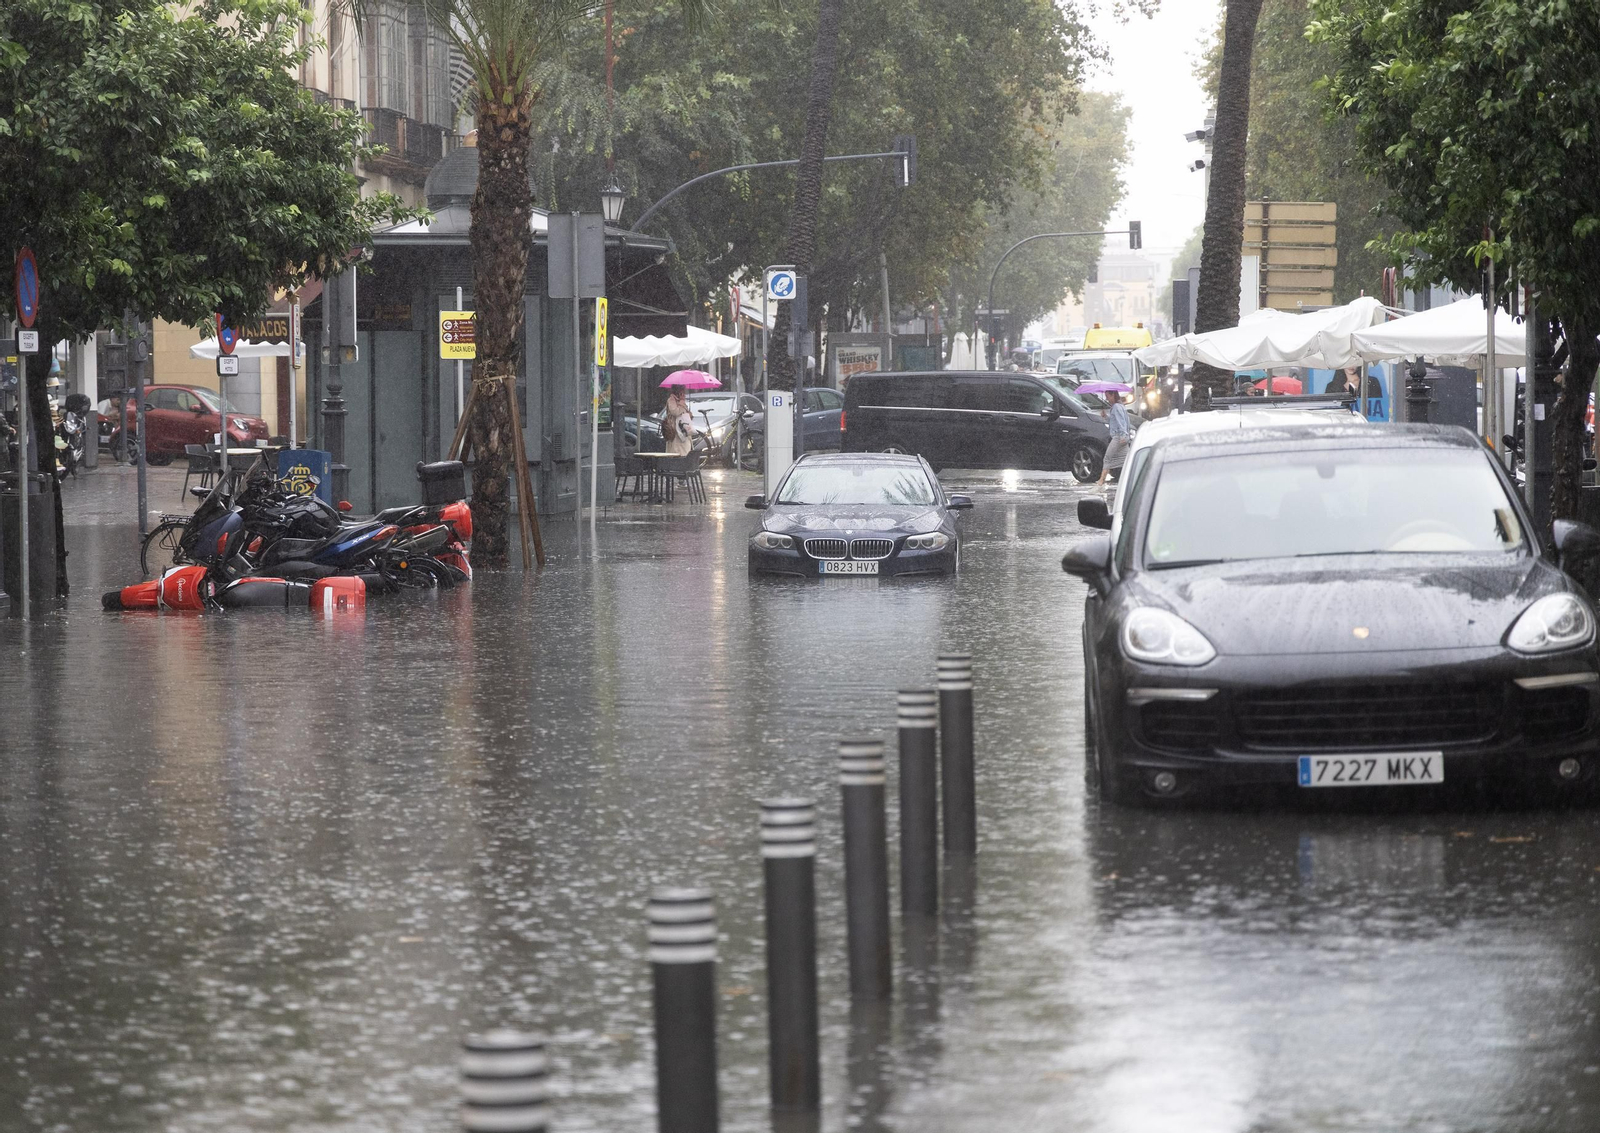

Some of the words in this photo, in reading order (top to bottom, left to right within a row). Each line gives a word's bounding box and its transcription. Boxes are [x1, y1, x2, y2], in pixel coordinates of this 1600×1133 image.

[838, 354, 880, 364] WHISKEY
[826, 562, 854, 573] 0823
[856, 562, 877, 573] HVX
[1316, 759, 1377, 782] 7227
[1387, 757, 1433, 781] MKX
